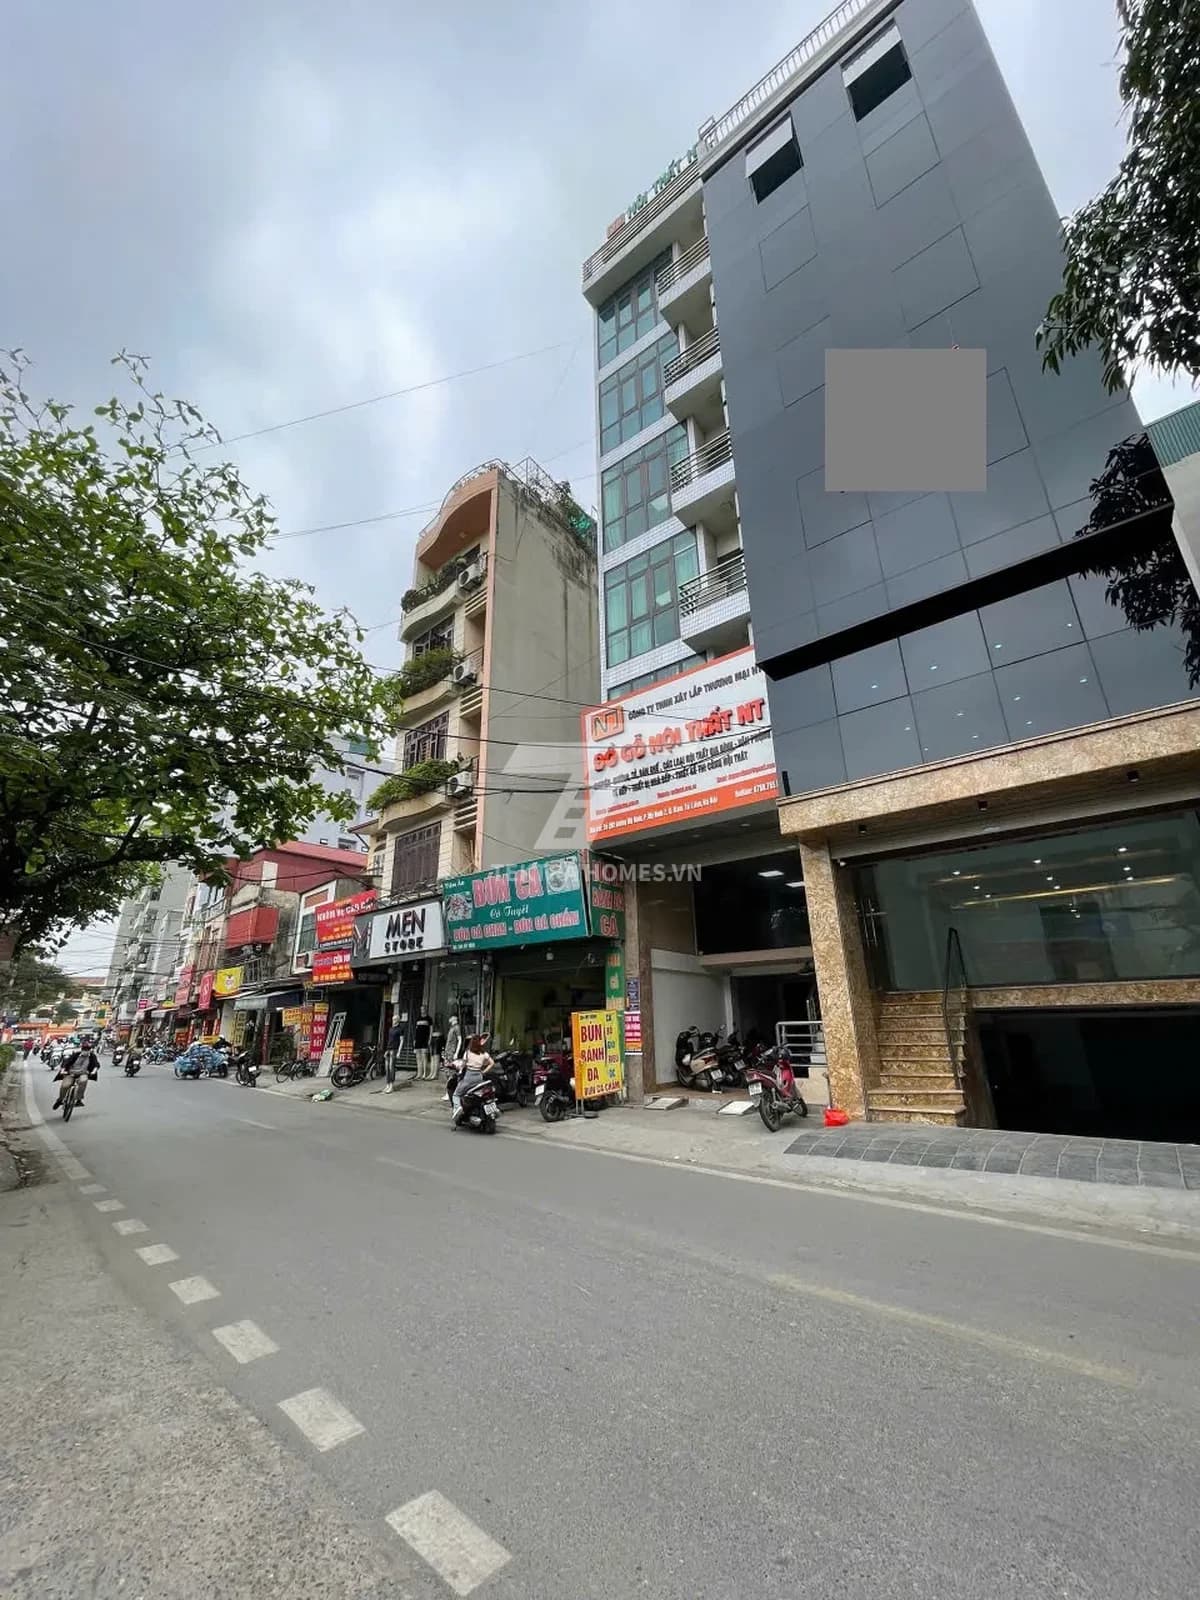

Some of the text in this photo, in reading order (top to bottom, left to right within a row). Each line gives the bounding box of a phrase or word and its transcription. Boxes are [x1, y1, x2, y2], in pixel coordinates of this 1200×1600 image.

[649, 726, 681, 755] NỘI
[685, 706, 733, 742] THẤT
[737, 698, 765, 726] NT
[472, 862, 544, 908] BÚN CÁ
[386, 908, 426, 939] MEN
[384, 937, 423, 954] STORE
[581, 1021, 602, 1043] BÚN
[581, 1046, 605, 1062] BÁNH
